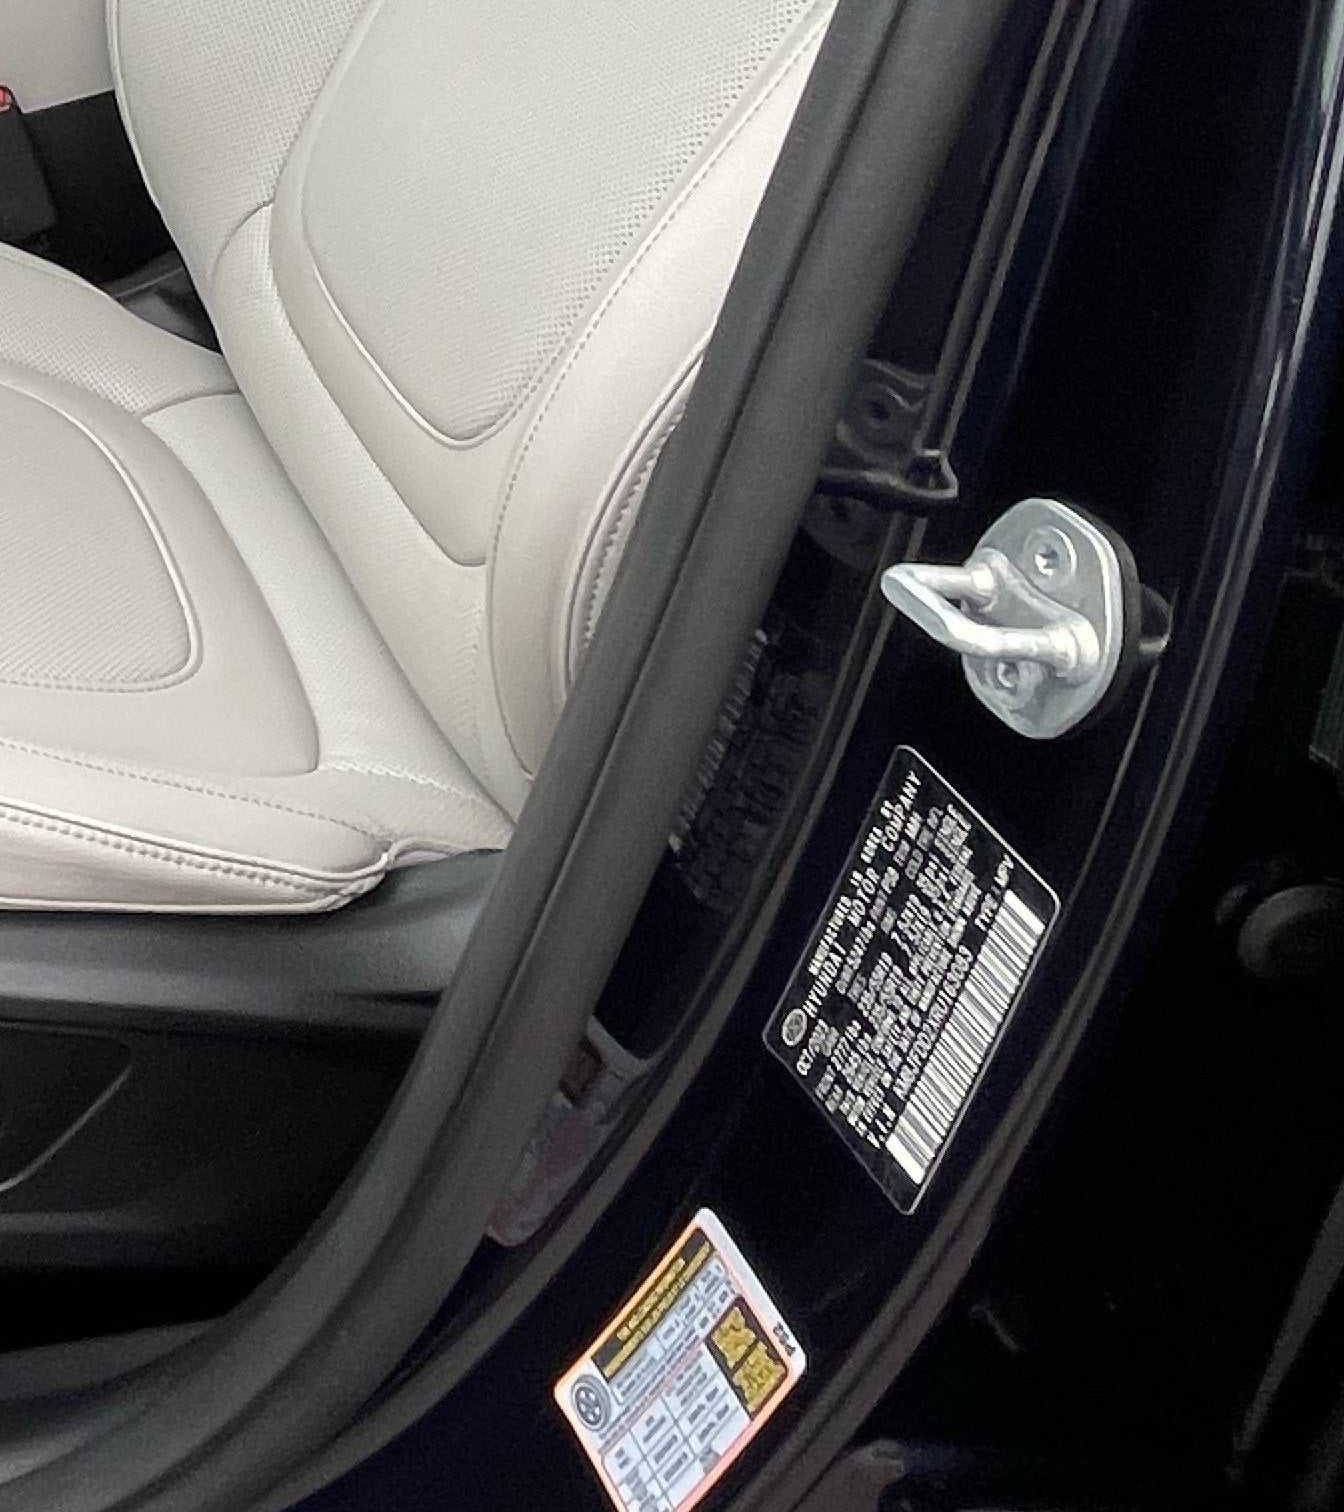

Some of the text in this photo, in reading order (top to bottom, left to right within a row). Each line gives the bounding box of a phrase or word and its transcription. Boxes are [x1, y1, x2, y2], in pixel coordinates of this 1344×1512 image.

[803, 936, 846, 1018] HYUNDAI
[846, 867, 880, 927] MOTOR
[878, 771, 921, 851] COMPANY
